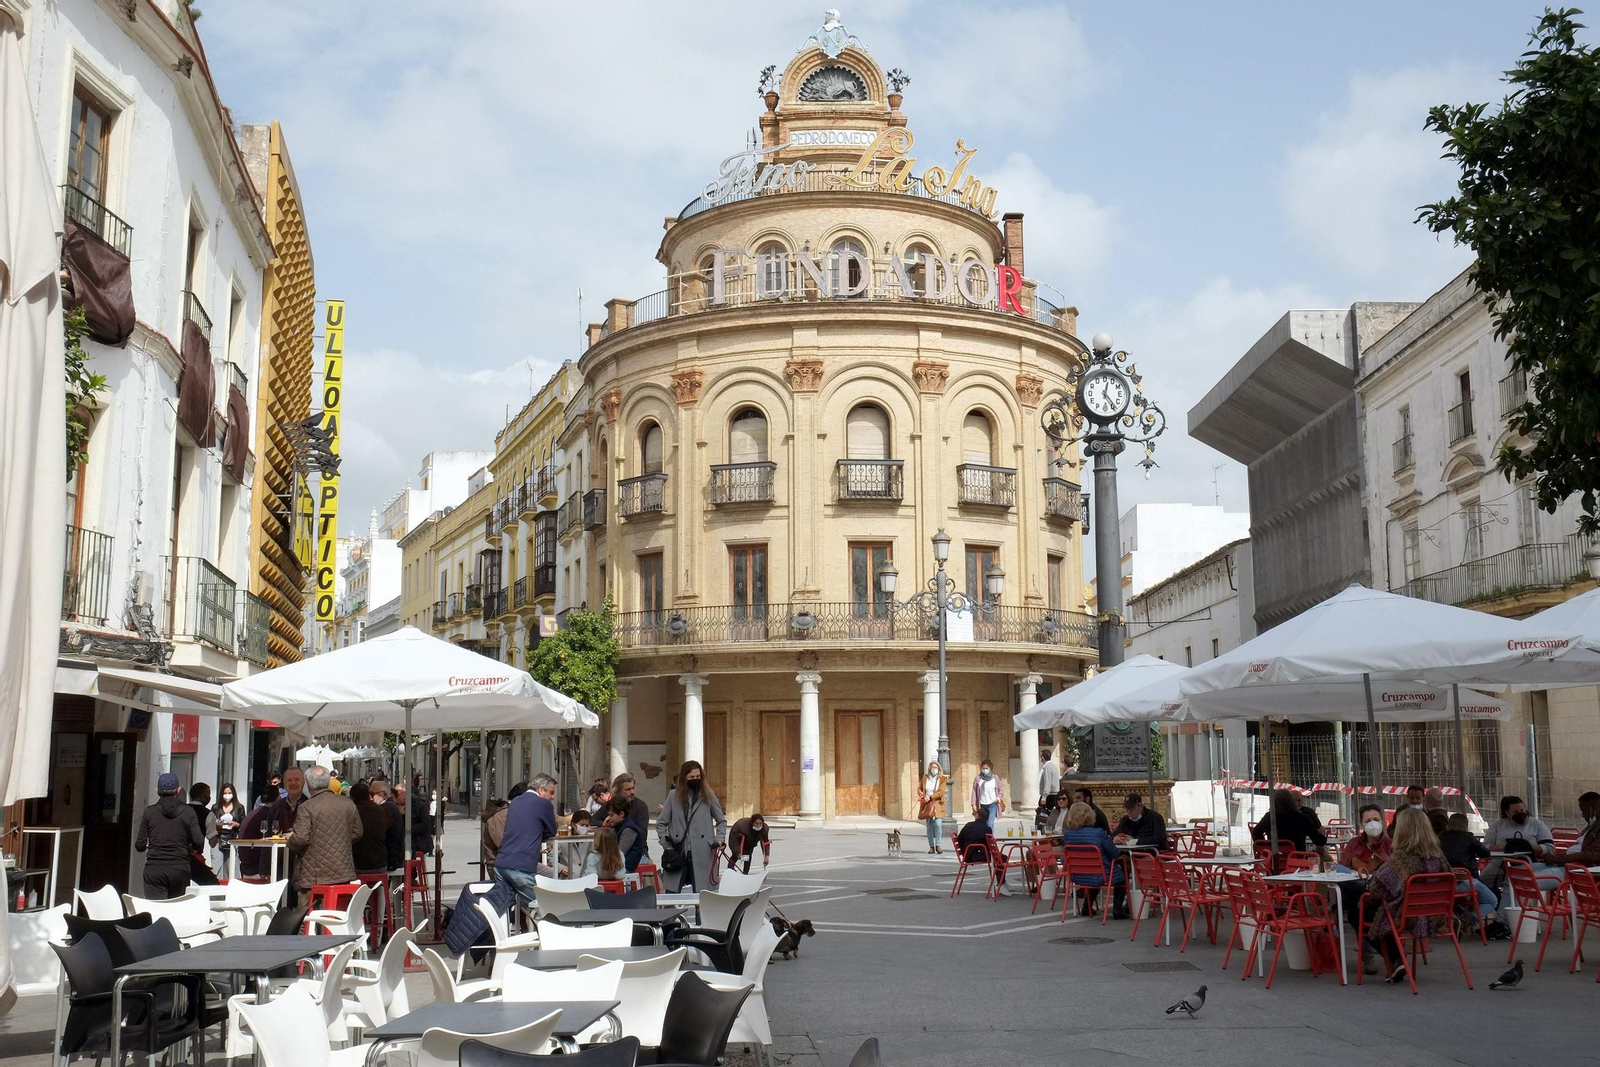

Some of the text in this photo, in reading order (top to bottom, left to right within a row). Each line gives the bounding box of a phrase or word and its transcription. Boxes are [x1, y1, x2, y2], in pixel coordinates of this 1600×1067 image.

[702, 142, 817, 203] Fino
[824, 126, 918, 191] La
[710, 249, 1029, 316] FUNDADOR
[324, 305, 343, 437] ULLOA
[1507, 639, 1569, 651] Cruzcampo
[1382, 692, 1436, 702] Cruzcampo
[1103, 736, 1142, 745] PEDRO
